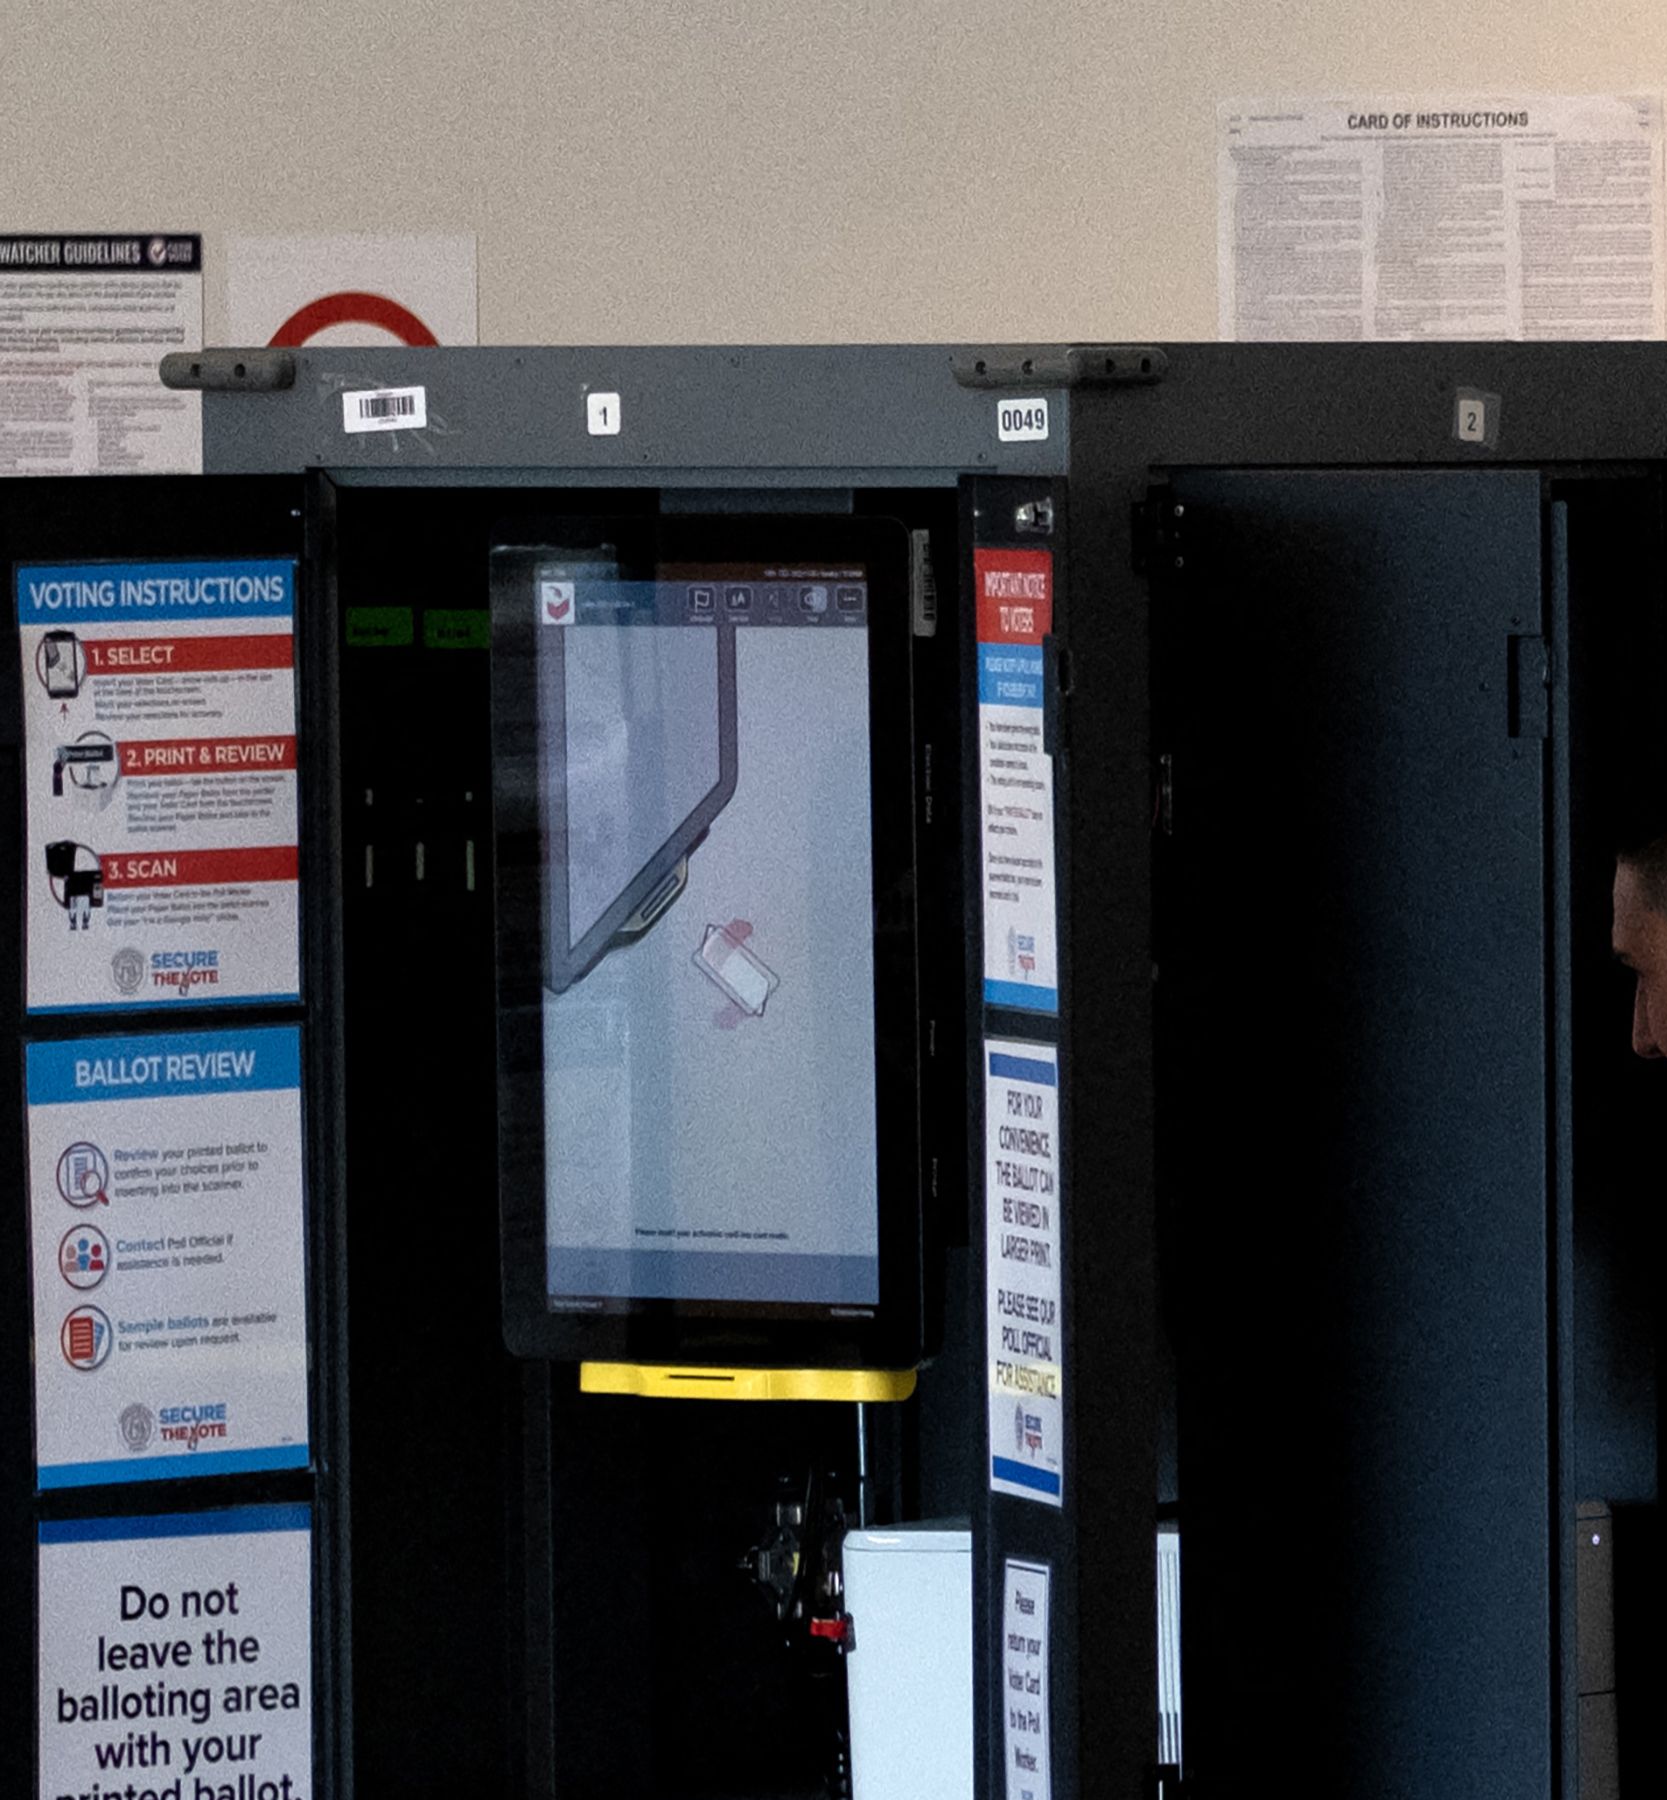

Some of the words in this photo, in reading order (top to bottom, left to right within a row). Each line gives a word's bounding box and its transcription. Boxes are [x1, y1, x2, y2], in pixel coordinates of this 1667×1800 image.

[1347, 113, 1389, 130] CARD
[1392, 113, 1412, 129] OF
[1416, 111, 1529, 128] INSTRUCTIONS
[0, 241, 60, 266] WATCHER
[64, 241, 141, 265] GUIDELINES
[599, 406, 608, 426] 1
[1001, 409, 1045, 431] 0049
[1467, 412, 1477, 432] 2
[29, 581, 114, 610] VOTING
[121, 575, 284, 606] INSTRUCTIONS
[92, 649, 104, 666] 1.
[107, 646, 175, 665] SELECT
[127, 750, 141, 767] 2.
[145, 746, 196, 766] PRINT
[199, 746, 211, 764] &
[216, 744, 286, 763] REVIEW
[108, 862, 123, 879] 3.
[127, 859, 177, 879] SCAN
[151, 951, 219, 968] SECURE
[75, 1057, 162, 1088] BALLOT
[167, 1051, 256, 1081] REVIEW
[114, 1150, 158, 1162] Review
[162, 1150, 184, 1161] your
[187, 1145, 223, 1160] printed
[226, 1143, 255, 1156] ballot
[258, 1142, 268, 1152] to
[114, 1167, 151, 1180] confirm
[155, 1167, 177, 1180] your
[180, 1162, 219, 1176] choices
[222, 1160, 245, 1174] prior
[249, 1160, 259, 1171] to
[117, 1238, 164, 1250] Contact
[168, 1237, 187, 1249] Poll
[189, 1235, 224, 1248] Official
[227, 1234, 234, 1246] if
[118, 1321, 164, 1335] Sample
[167, 1316, 209, 1330] ballots
[212, 1317, 229, 1327] are
[232, 1313, 277, 1326] available
[118, 1339, 132, 1350] for
[135, 1338, 168, 1349] review
[171, 1336, 198, 1349] upon
[159, 1404, 226, 1423] SECURE
[121, 1586, 168, 1621] Do
[181, 1583, 238, 1618] not
[99, 1637, 191, 1671] leave
[203, 1630, 259, 1664] the
[57, 1683, 211, 1724] balloting
[223, 1681, 300, 1713] area
[95, 1733, 170, 1769] with
[183, 1734, 261, 1774] your
